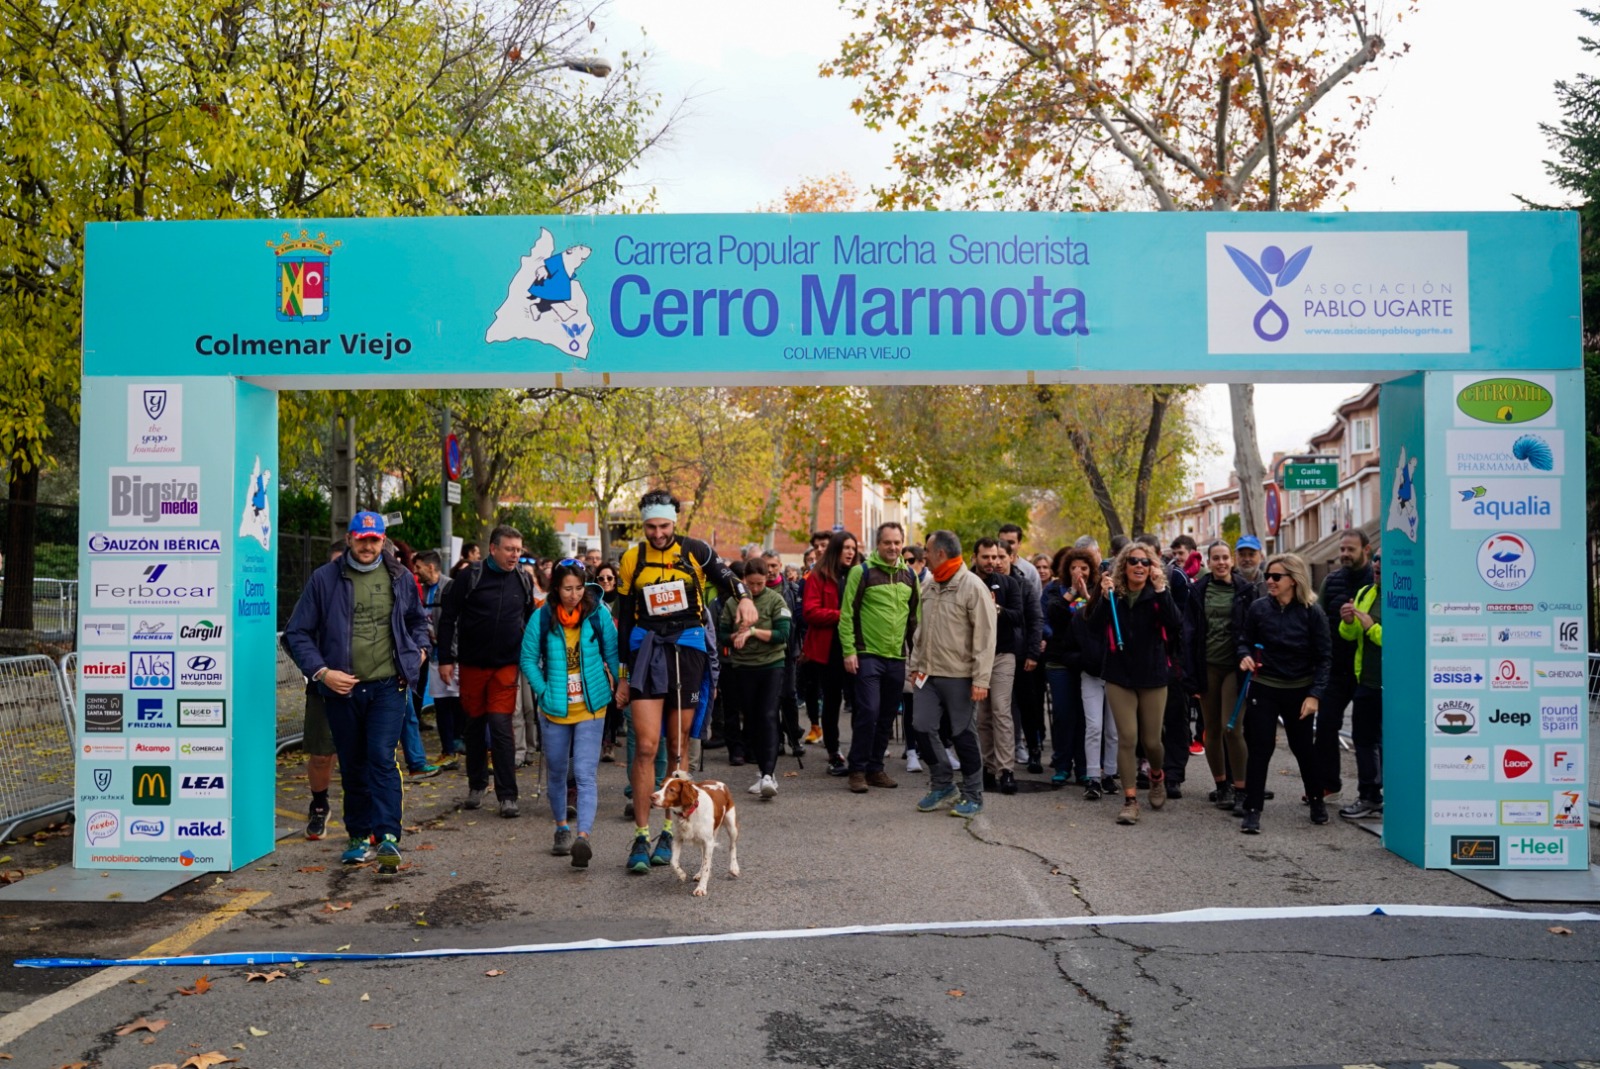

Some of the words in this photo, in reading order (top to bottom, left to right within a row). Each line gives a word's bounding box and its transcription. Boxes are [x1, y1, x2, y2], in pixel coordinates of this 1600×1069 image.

[614, 235, 712, 265] Carrera
[719, 234, 821, 272] Popular
[833, 234, 936, 265] Marcha
[948, 233, 1090, 265] Senderista
[1304, 281, 1453, 295] ASOCIACIÓN
[610, 273, 780, 338] Cerro
[800, 273, 1089, 338] Marmota
[1304, 299, 1366, 318] PABLO
[1374, 299, 1453, 318] UGARTE
[1304, 326, 1454, 338] www.asociacionpablougarte.es
[195, 334, 331, 355] Colmenar
[339, 333, 412, 361] Viejo
[783, 347, 867, 360] COLMENAR
[869, 347, 912, 360] VIEJO
[1462, 383, 1547, 403] CITROMIL
[148, 424, 161, 433] the
[142, 434, 168, 444] yago
[133, 445, 176, 454] foundation
[1457, 452, 1513, 461] FUNDACIÓN
[1457, 462, 1530, 471] PHARMAMAR
[161, 479, 198, 501] size
[111, 475, 161, 523] Big
[161, 498, 198, 515] media
[1473, 496, 1551, 520] aqualia
[89, 535, 159, 552] GAUZÓN
[164, 536, 220, 550] IBÉRICA
[1486, 563, 1526, 578] delfín
[244, 579, 265, 597] Cerro
[1392, 571, 1412, 591] Cerro
[95, 584, 215, 598] Ferbocar
[655, 591, 675, 604] 809
[238, 599, 270, 616] Marmota
[1387, 591, 1419, 611] Marmota
[1444, 603, 1480, 613] pharmashop
[180, 625, 223, 641] Cargill
[1559, 622, 1578, 641] HR
[84, 662, 126, 674] mirai
[134, 655, 170, 676] Alés
[1433, 673, 1472, 683] asisa
[1548, 670, 1583, 678] GHENOVA
[567, 682, 582, 693] 08
[1541, 704, 1578, 715] round
[1488, 709, 1531, 726] Jeep
[1542, 721, 1578, 733] spain
[135, 743, 170, 752] Alcampo
[1504, 759, 1530, 767] Lacer
[181, 776, 224, 789] LEA
